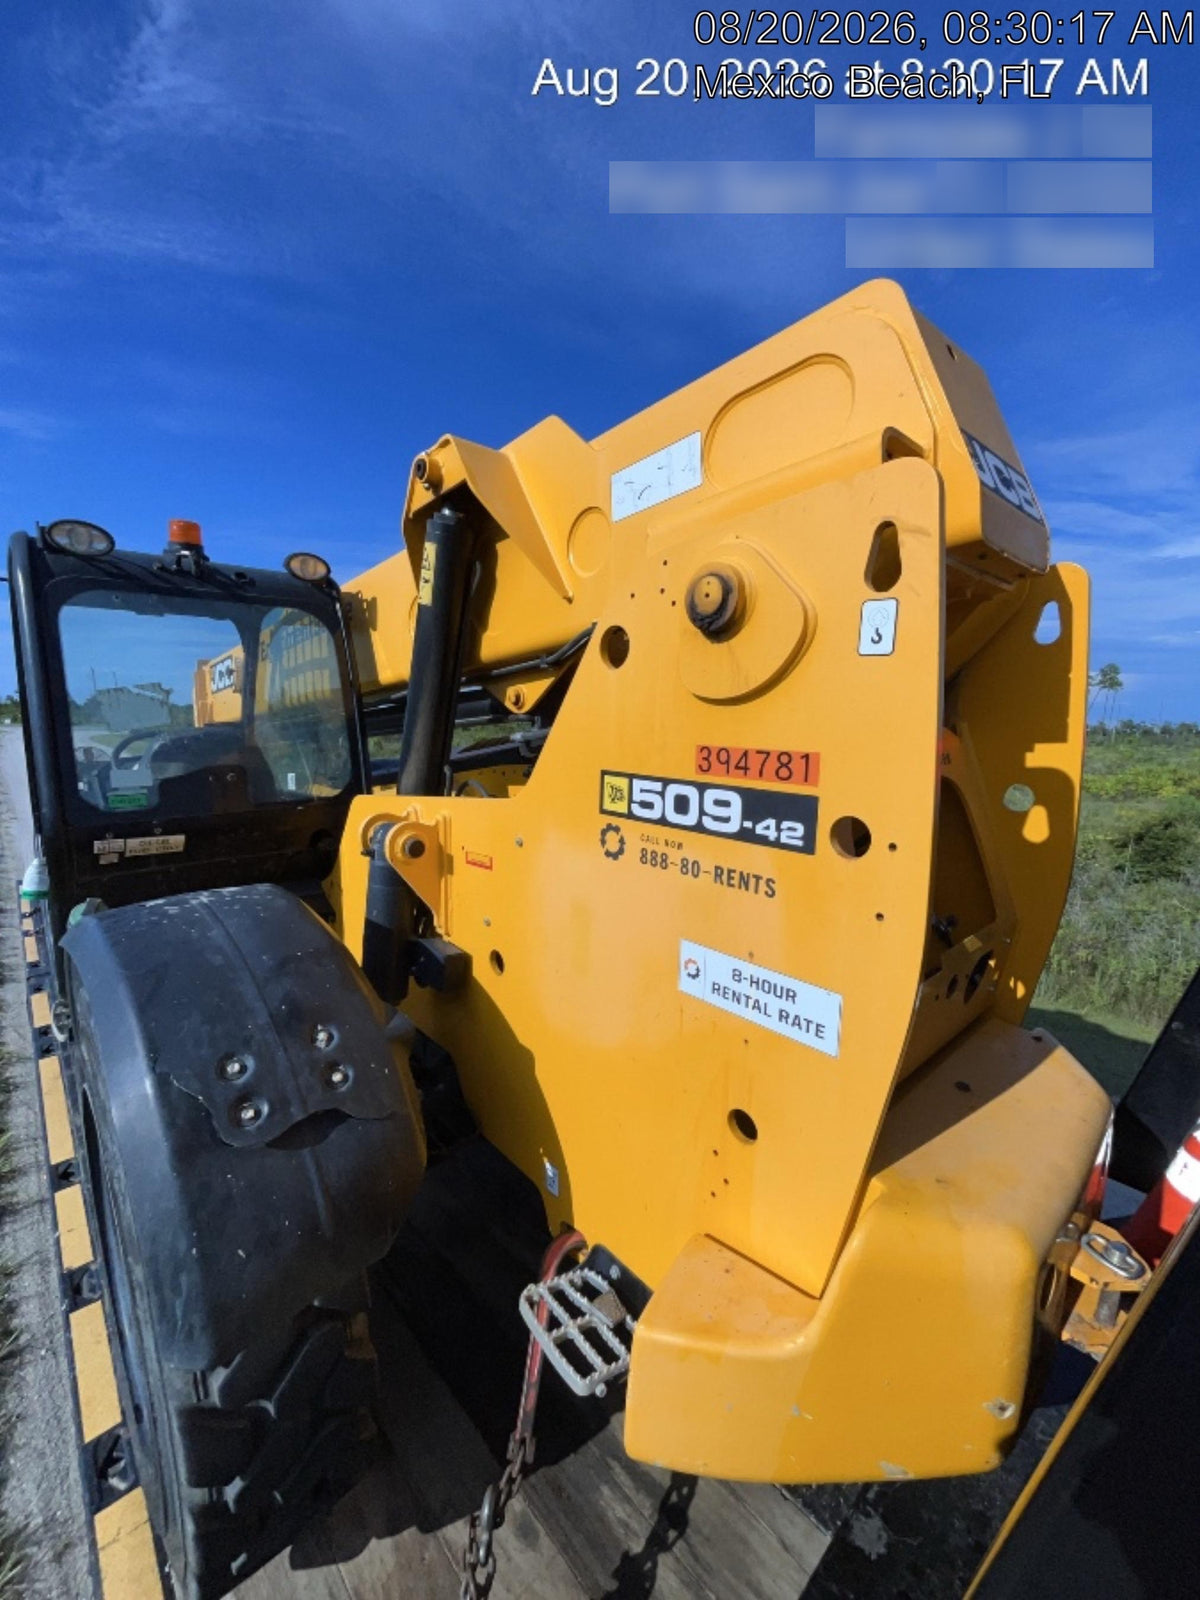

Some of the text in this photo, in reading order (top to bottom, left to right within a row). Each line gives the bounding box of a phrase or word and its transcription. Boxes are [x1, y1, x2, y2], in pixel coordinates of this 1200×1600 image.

[969, 440, 1041, 521] JCB
[697, 746, 811, 783] 394781
[640, 833, 683, 850] CALL NOW
[639, 847, 776, 898] 888-80-RENTS
[731, 968, 797, 1004] 8-HOUR
[711, 981, 826, 1040] RENTAL RATE
